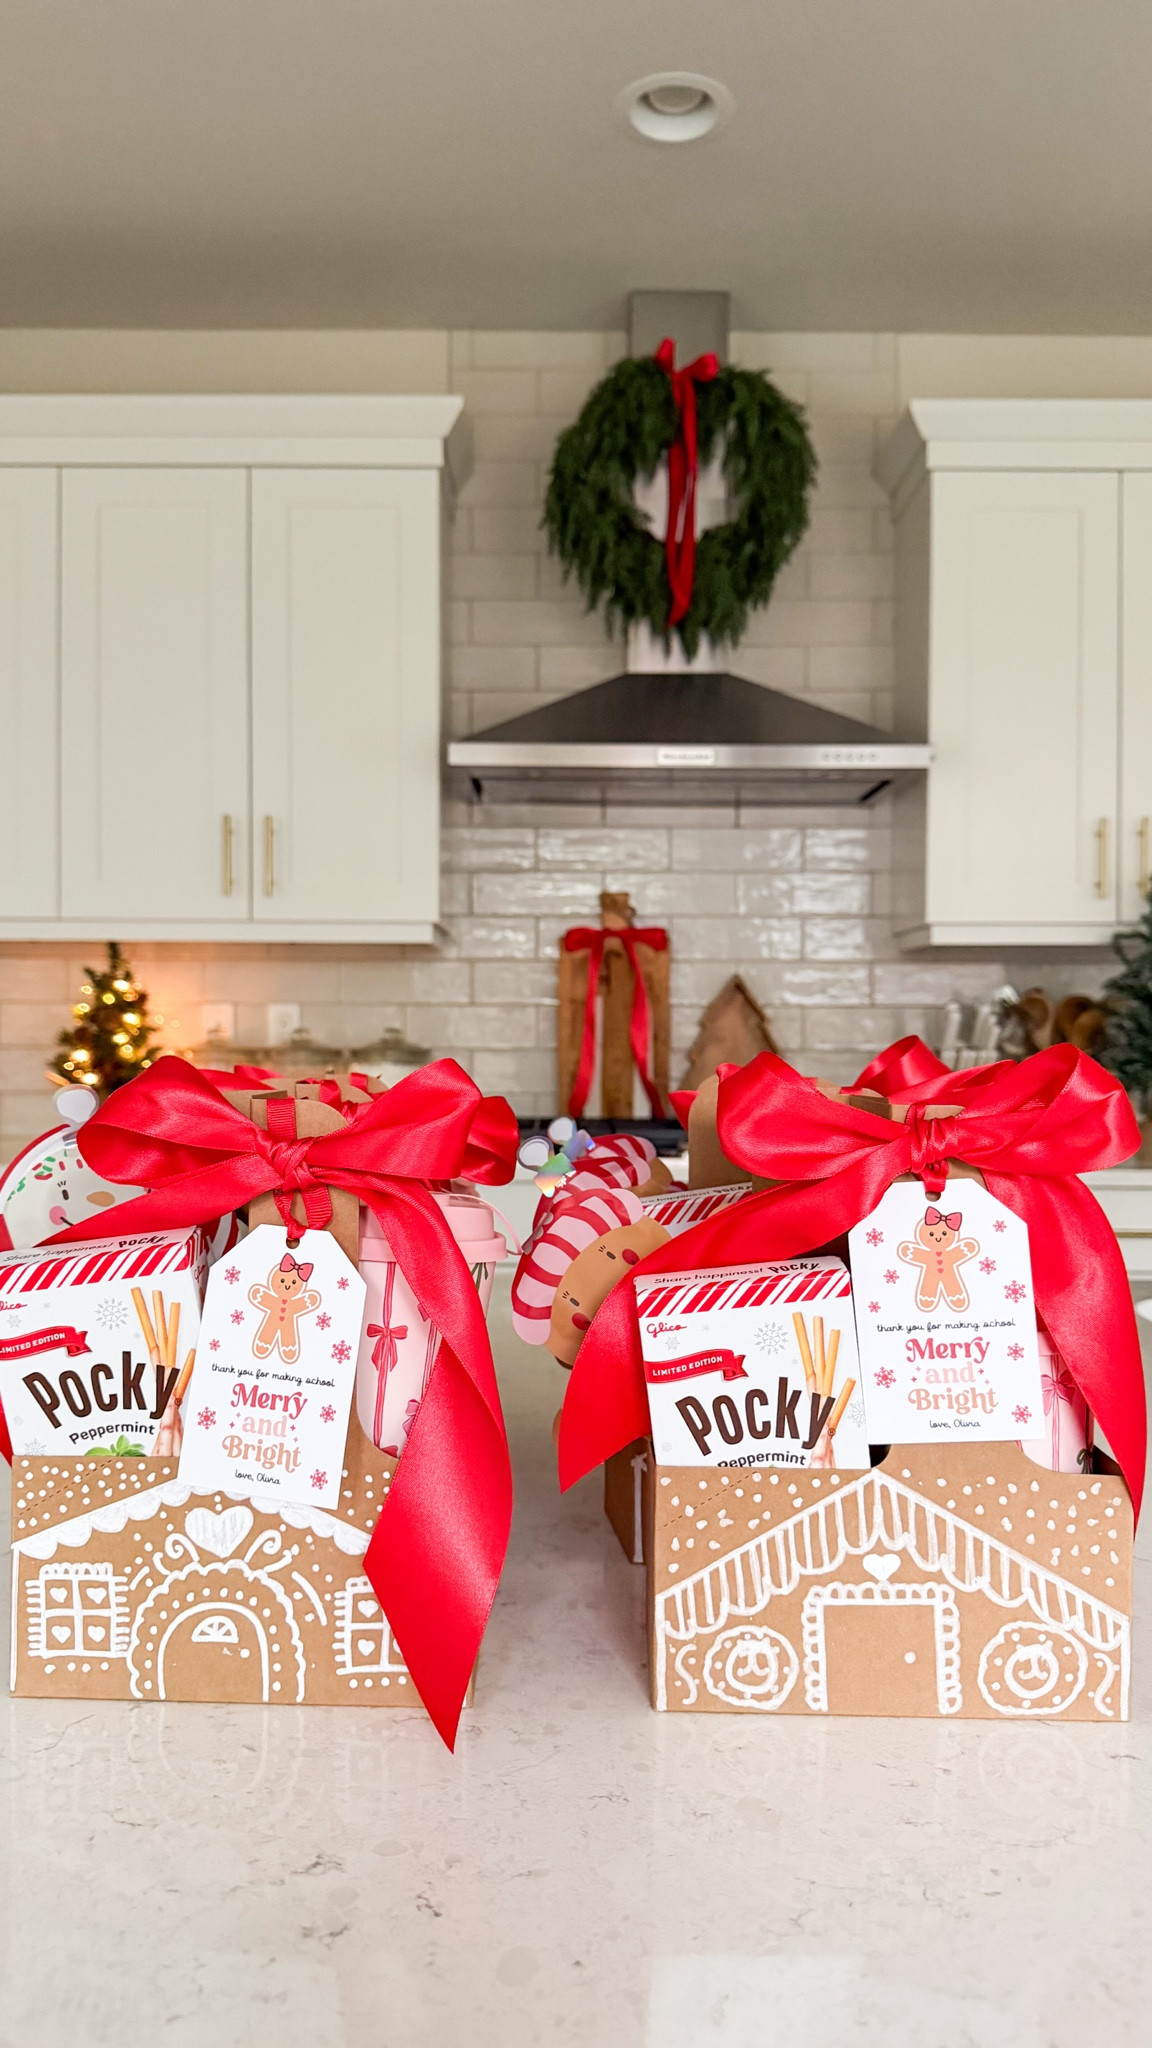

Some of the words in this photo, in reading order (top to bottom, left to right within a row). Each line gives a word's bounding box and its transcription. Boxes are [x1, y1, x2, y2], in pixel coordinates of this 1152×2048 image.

[3, 1252, 40, 1262] Share
[43, 1243, 113, 1258] happiness!
[654, 1276, 692, 1284] Share
[694, 1268, 763, 1280] happiness!
[767, 1262, 820, 1274] Pocky
[0, 1300, 28, 1311] lico
[646, 1322, 687, 1338] Glico
[877, 1323, 904, 1332] thank
[906, 1323, 924, 1334] you
[927, 1322, 941, 1332] for
[945, 1320, 980, 1332] making
[983, 1318, 1016, 1328] school
[32, 1332, 66, 1347] EDITION
[905, 1336, 990, 1364] Merry
[212, 1363, 235, 1373] thank
[237, 1369, 254, 1378] you
[256, 1369, 269, 1380] for
[271, 1371, 303, 1386] making
[305, 1377, 335, 1387] school
[652, 1364, 687, 1377] LIMITED
[689, 1355, 723, 1370] EDITION
[925, 1361, 976, 1384] and
[230, 1383, 308, 1420] Merry
[908, 1387, 999, 1415] Bright
[69, 1421, 155, 1445] Peppermint
[242, 1415, 288, 1438] and
[929, 1420, 951, 1428] love,
[953, 1419, 981, 1428] Olivia
[222, 1435, 301, 1473] Bright
[235, 1469, 254, 1481] love,
[256, 1472, 281, 1485] Olivia
